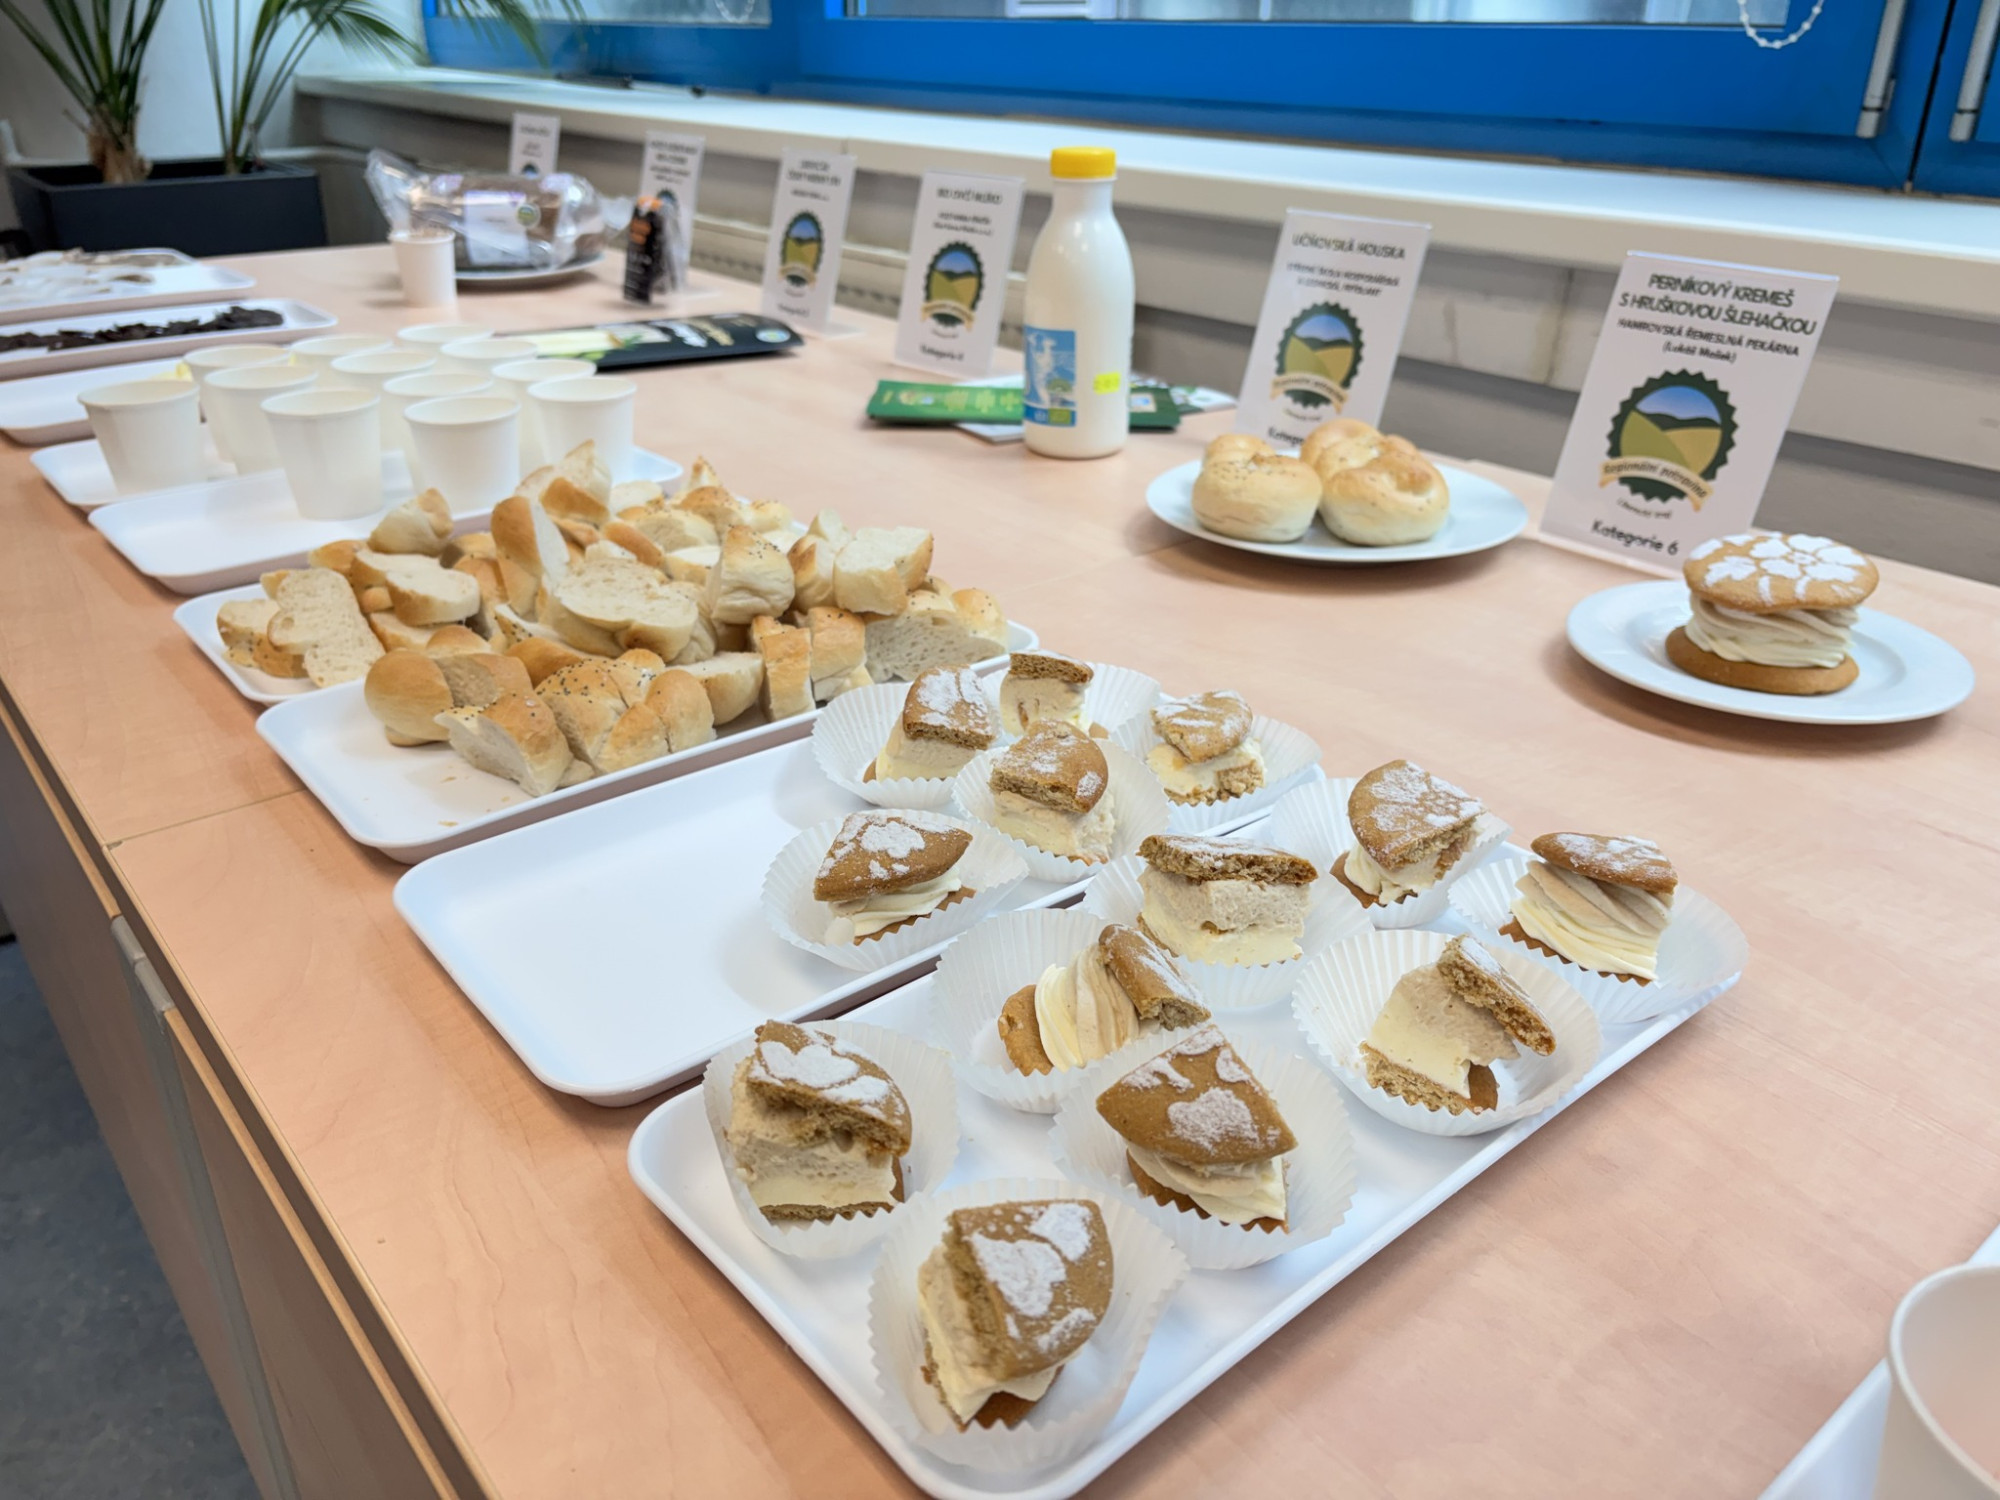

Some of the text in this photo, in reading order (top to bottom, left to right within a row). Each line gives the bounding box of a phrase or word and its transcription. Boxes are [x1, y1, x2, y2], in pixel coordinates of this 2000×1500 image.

[1649, 273, 1795, 308] PERNÍKOVÝ KREMEŠ
[1618, 292, 1817, 336] S HRUŠKOVOU ŠLEHAČKOU
[1685, 325, 1744, 348] ŘEMESLNÁ
[1744, 336, 1800, 357] PEKÁRNA
[1591, 519, 1680, 556] Kategorie 6
